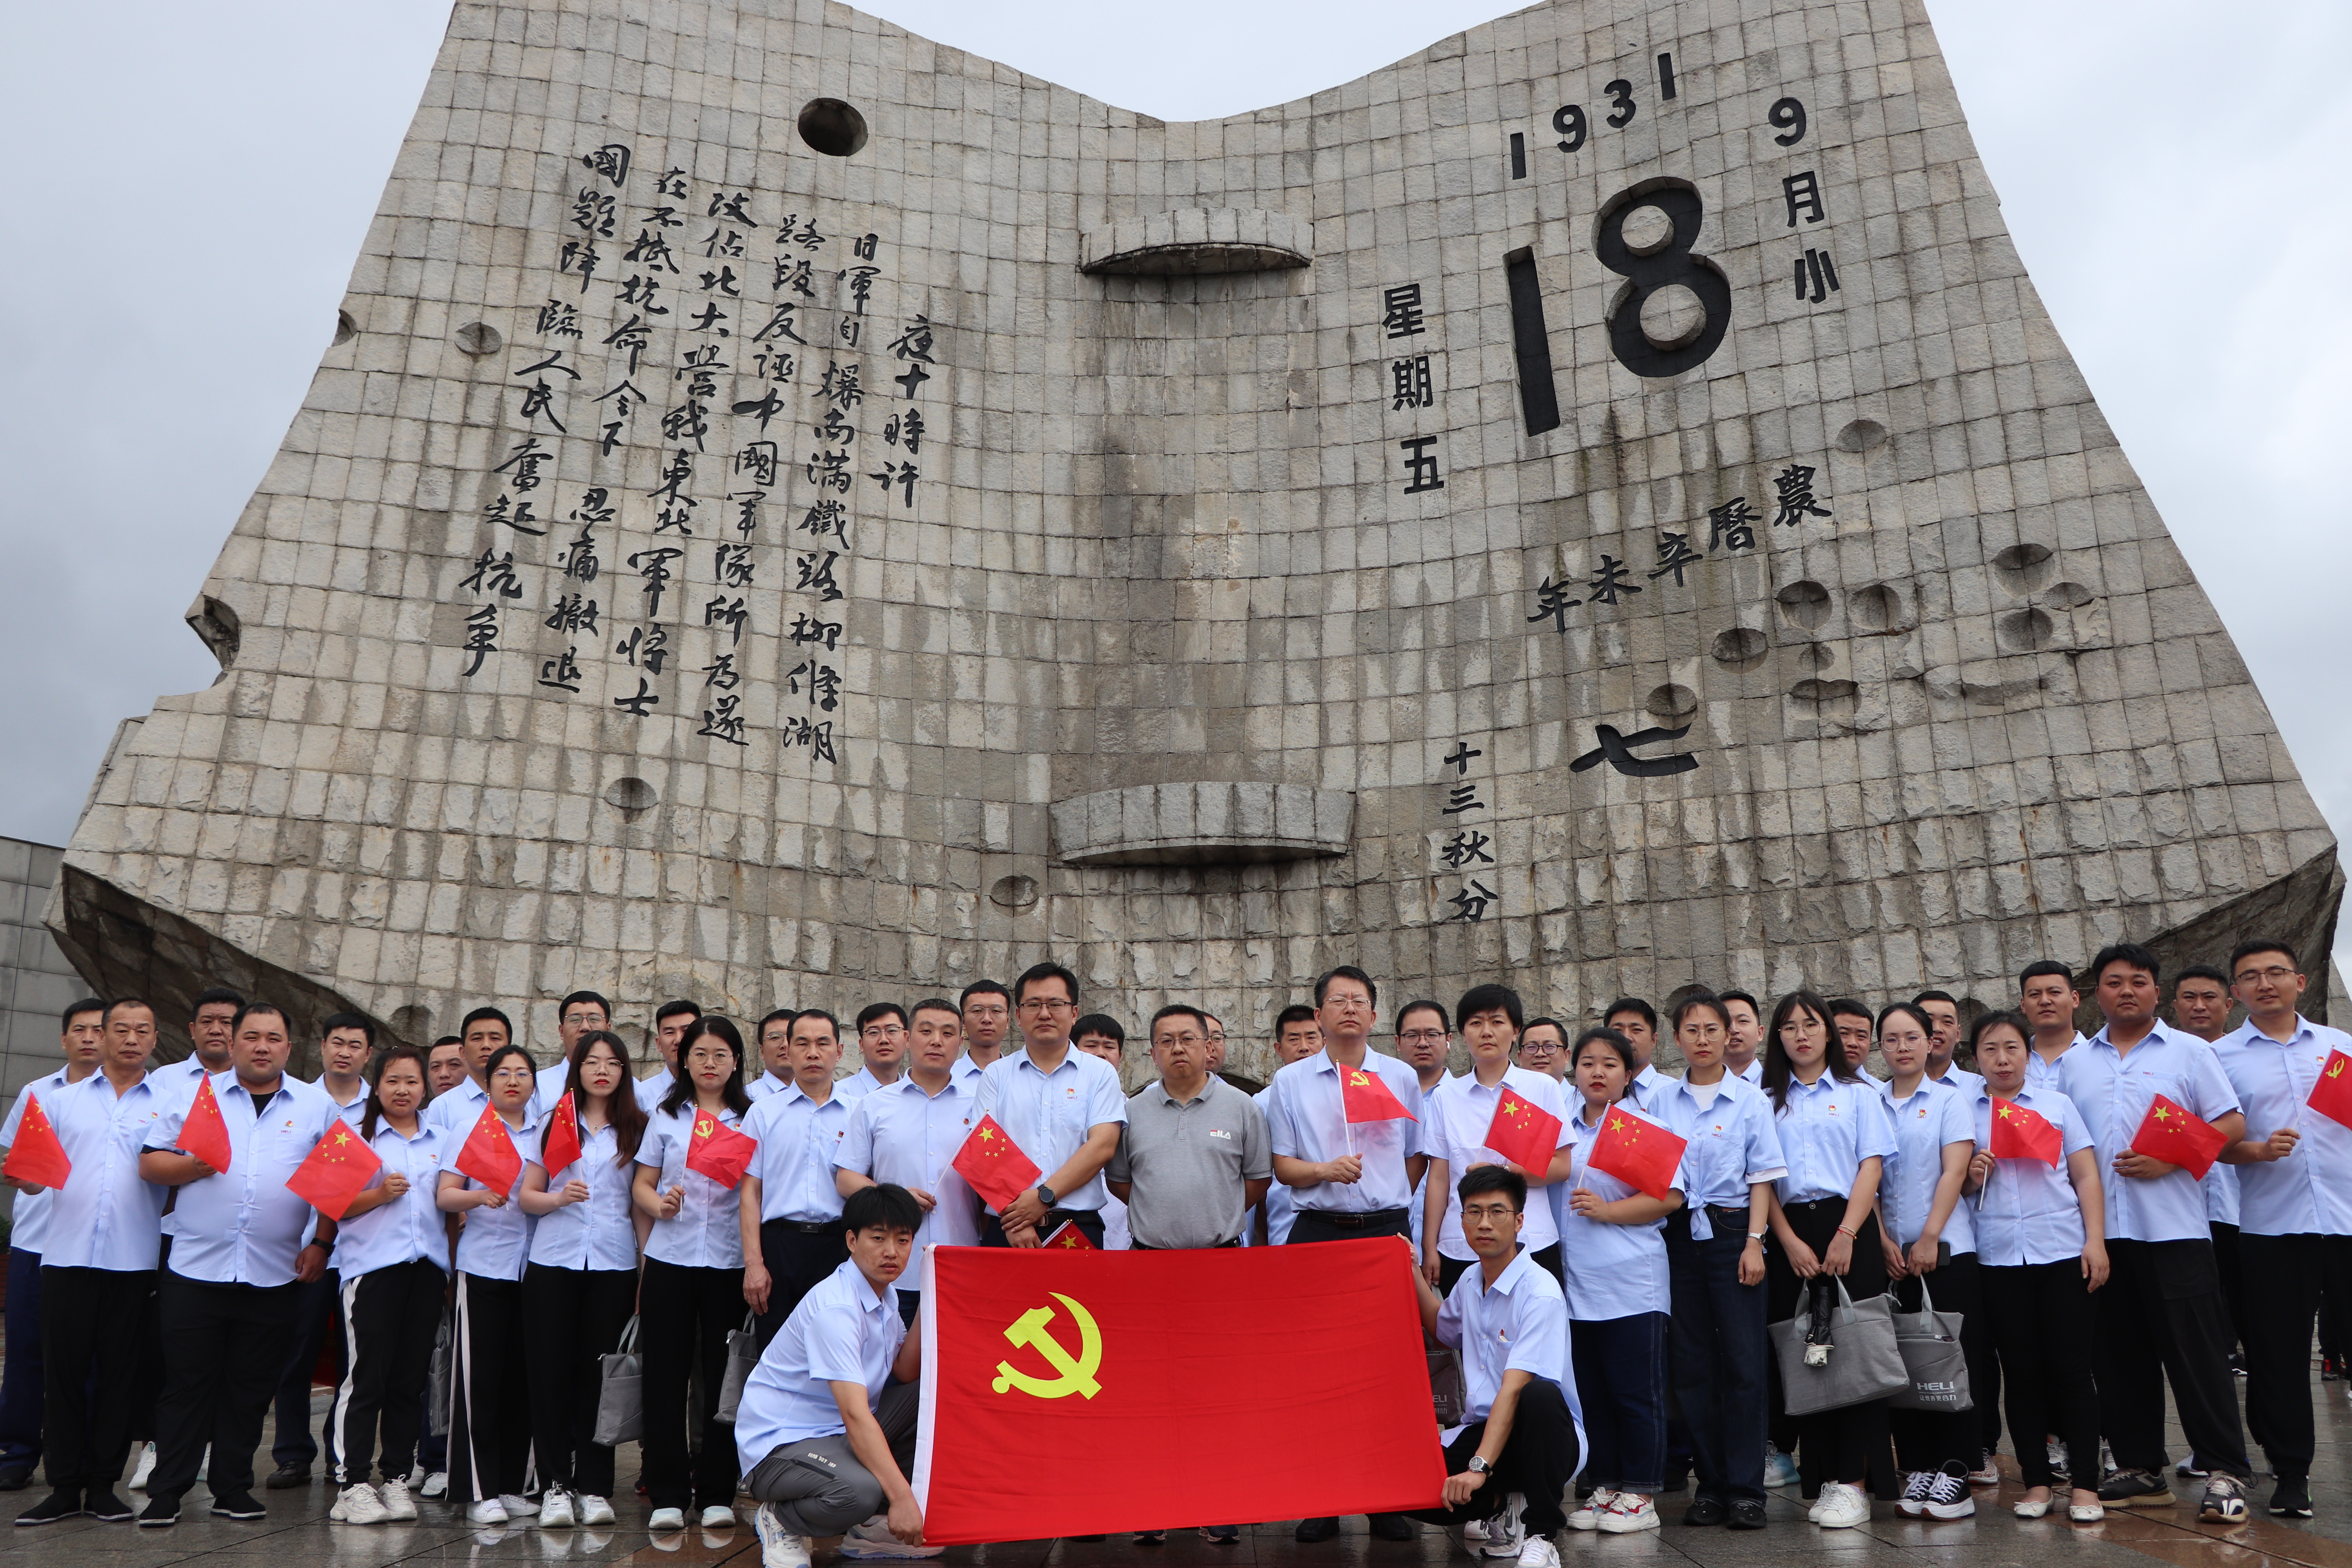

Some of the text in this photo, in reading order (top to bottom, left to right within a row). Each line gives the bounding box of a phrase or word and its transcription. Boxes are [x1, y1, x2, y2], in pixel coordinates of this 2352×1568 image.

[1510, 53, 1676, 180] 1931
[1382, 283, 1444, 494] 星期五
[1503, 176, 1731, 437] 18
[1439, 742, 1498, 922] 十三秋分
[1916, 1381, 1954, 1390] HELI
